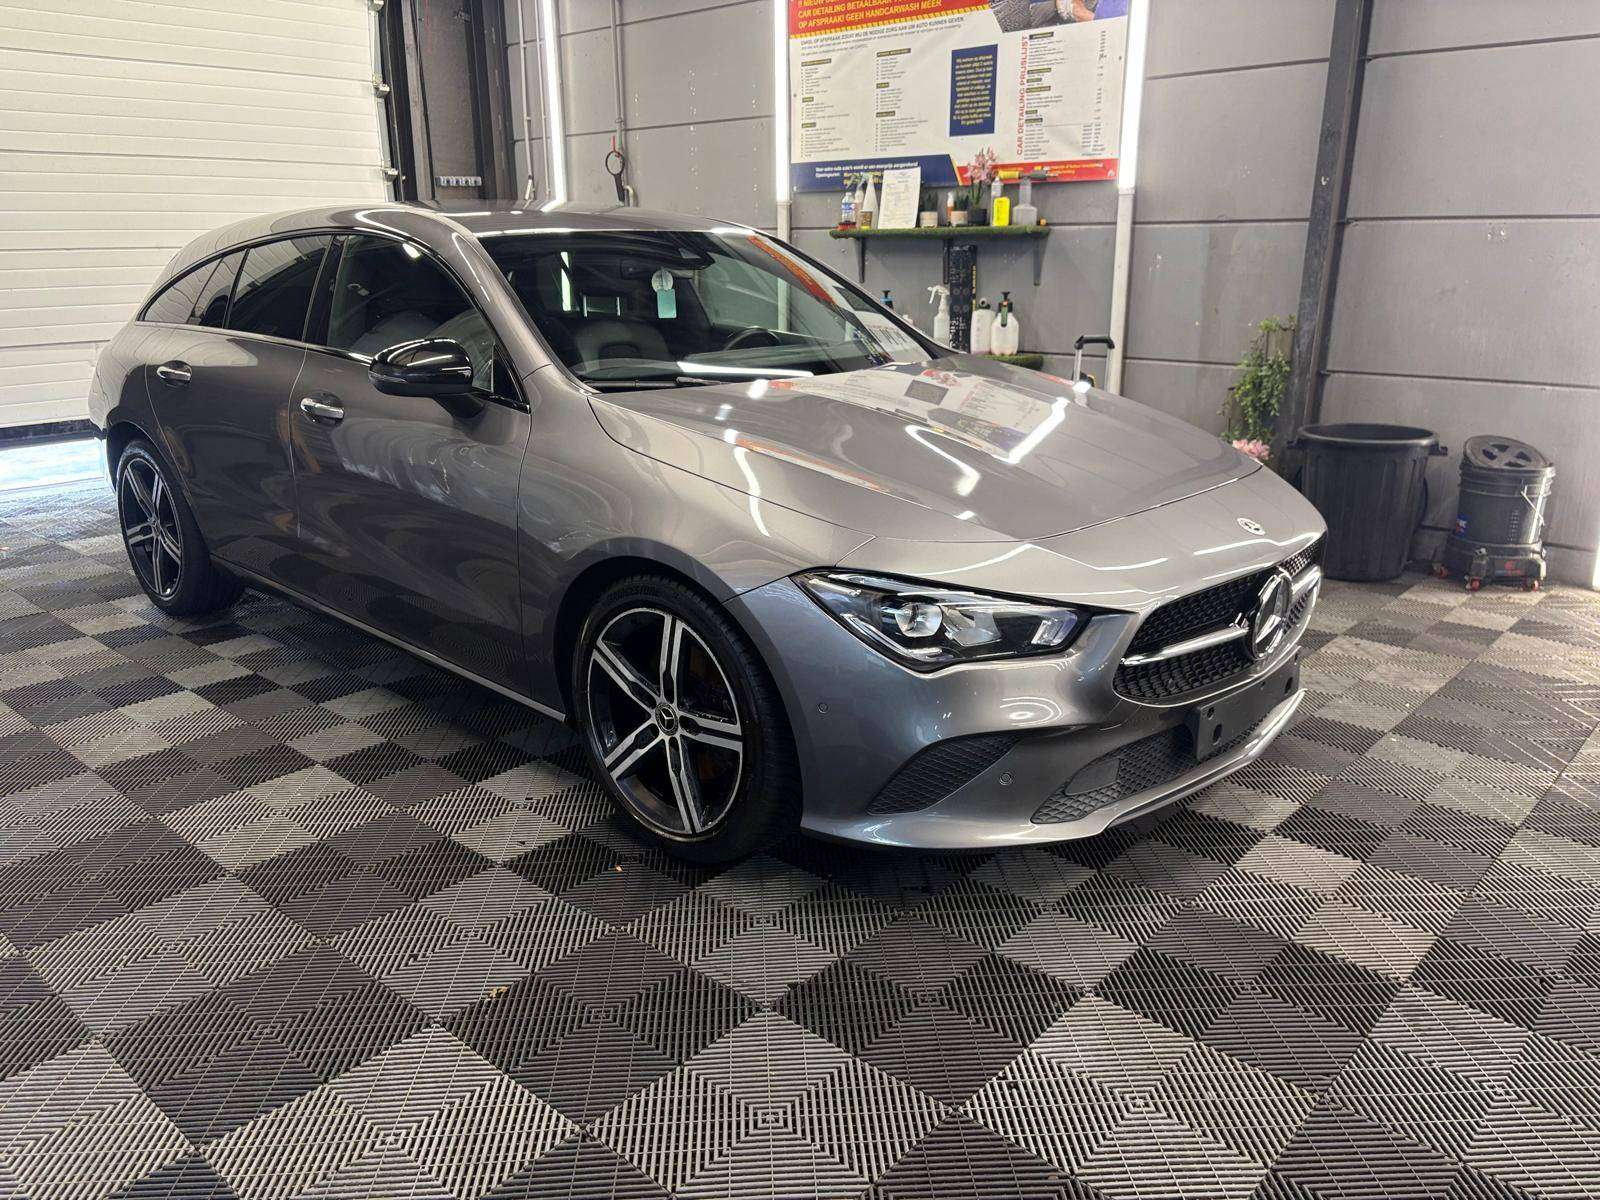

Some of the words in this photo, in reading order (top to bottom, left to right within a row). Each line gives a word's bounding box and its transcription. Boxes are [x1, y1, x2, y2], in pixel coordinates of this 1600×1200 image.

[798, 10, 813, 18] CAR
[813, 4, 846, 17] DETAILING
[846, 12, 864, 22] GEEN
[865, 3, 920, 18] HANDCARWASH
[920, 0, 942, 10] MEER
[1019, 36, 1029, 85] PRIJSLIJST
[1017, 88, 1026, 134] DETAILING
[1016, 135, 1024, 155] CAR
